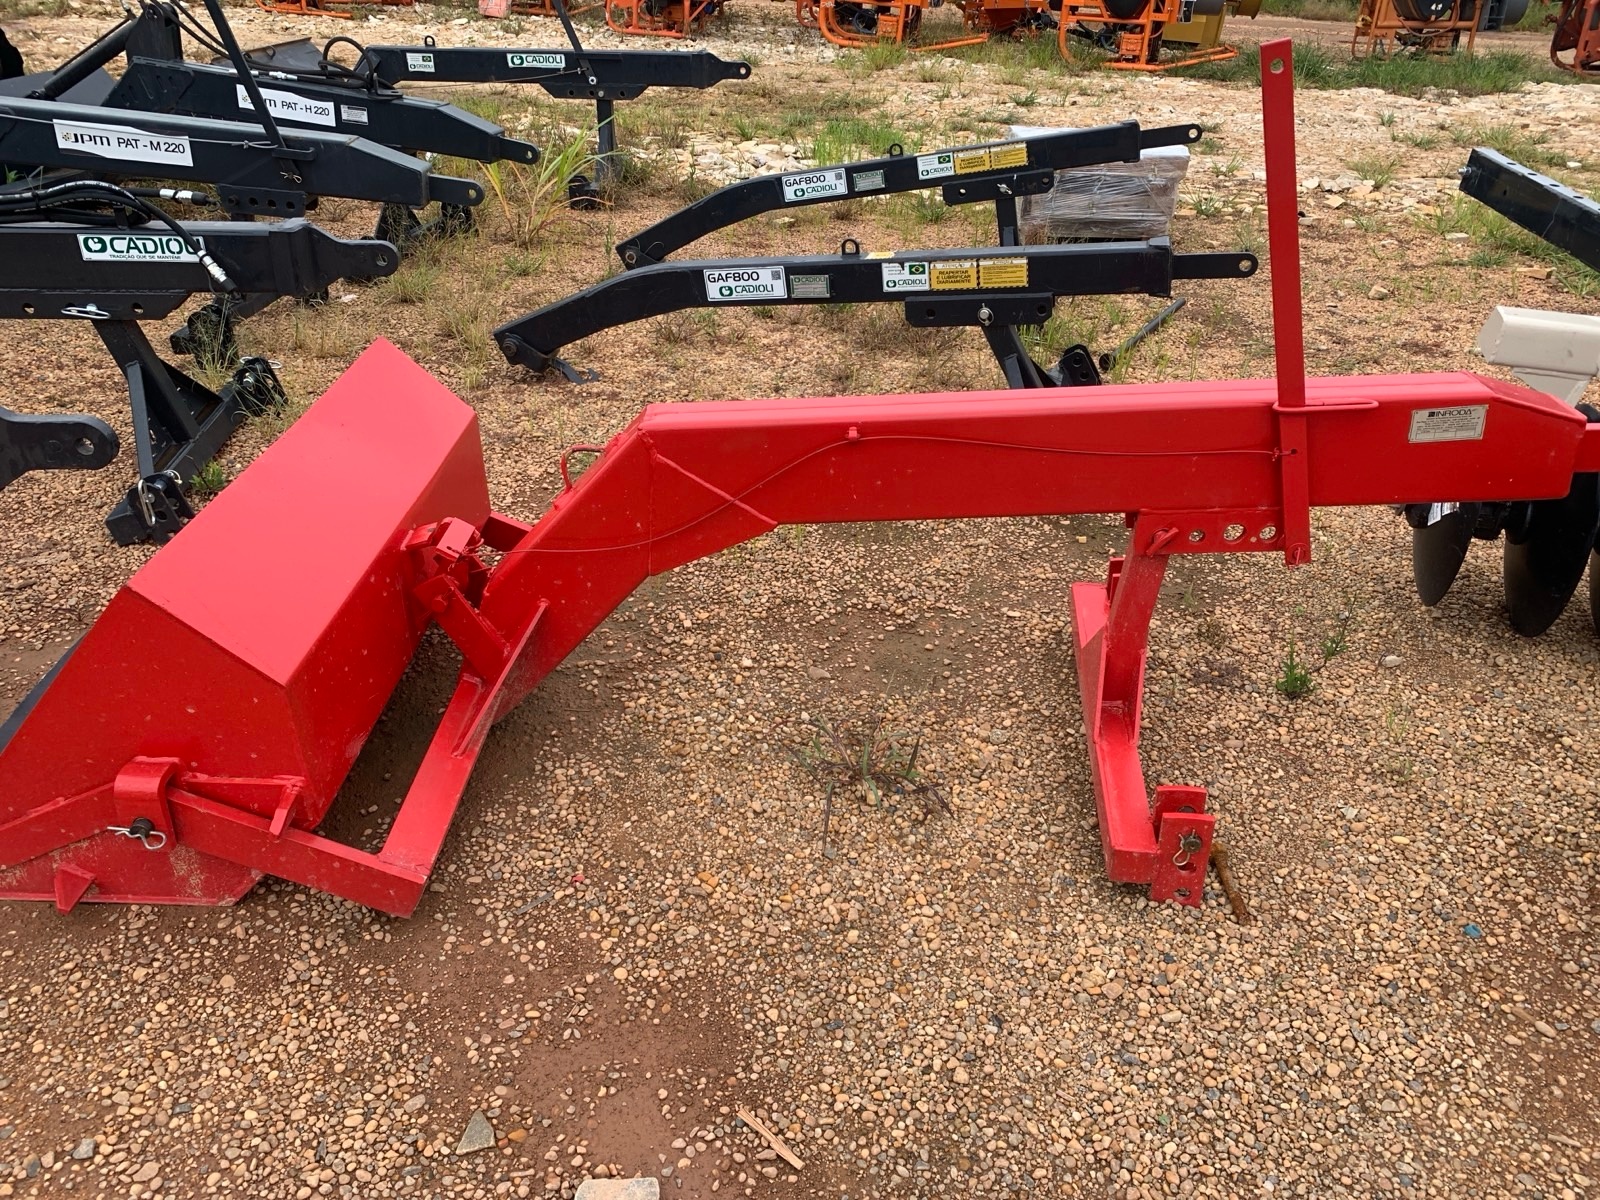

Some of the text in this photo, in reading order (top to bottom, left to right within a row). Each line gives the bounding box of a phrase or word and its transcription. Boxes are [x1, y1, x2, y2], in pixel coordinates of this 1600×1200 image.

[526, 55, 562, 64] CADIOLI
[281, 100, 298, 112] PAT
[314, 105, 330, 116] 220
[116, 137, 140, 149] PAT
[164, 142, 186, 154] 220
[784, 174, 826, 188] GAF800
[806, 183, 838, 194] CADIOLI
[707, 271, 760, 283] GAF800
[734, 284, 774, 294] CADIOLI
[1436, 408, 1472, 417] INRODA
